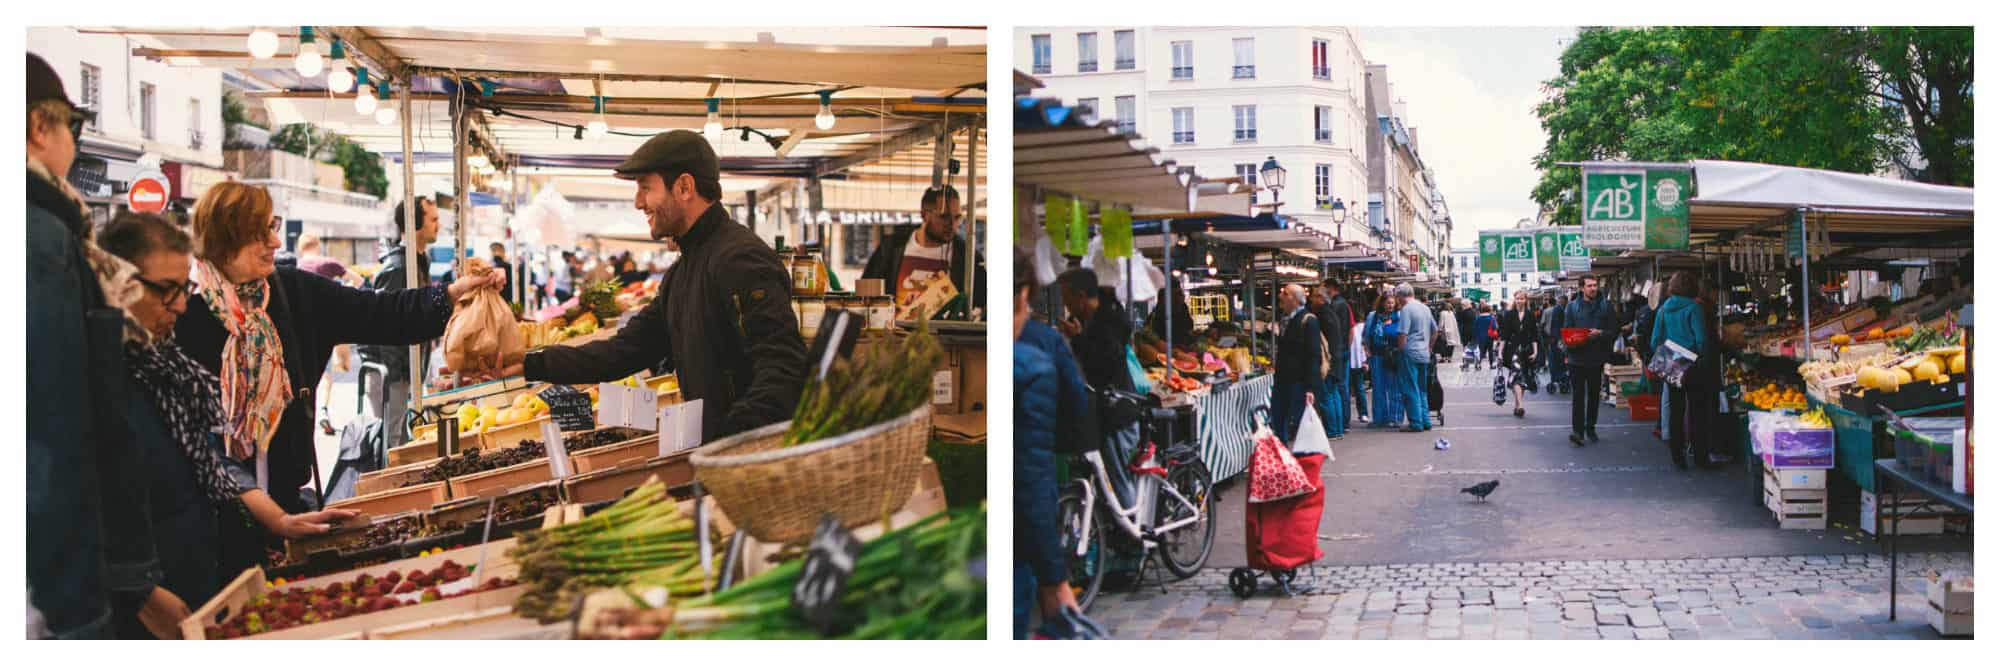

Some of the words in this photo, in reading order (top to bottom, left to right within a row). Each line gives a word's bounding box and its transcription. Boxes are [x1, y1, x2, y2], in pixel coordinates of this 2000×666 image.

[1590, 187, 1635, 219] AB
[1507, 243, 1529, 258] AB
[1563, 241, 1584, 256] AB
